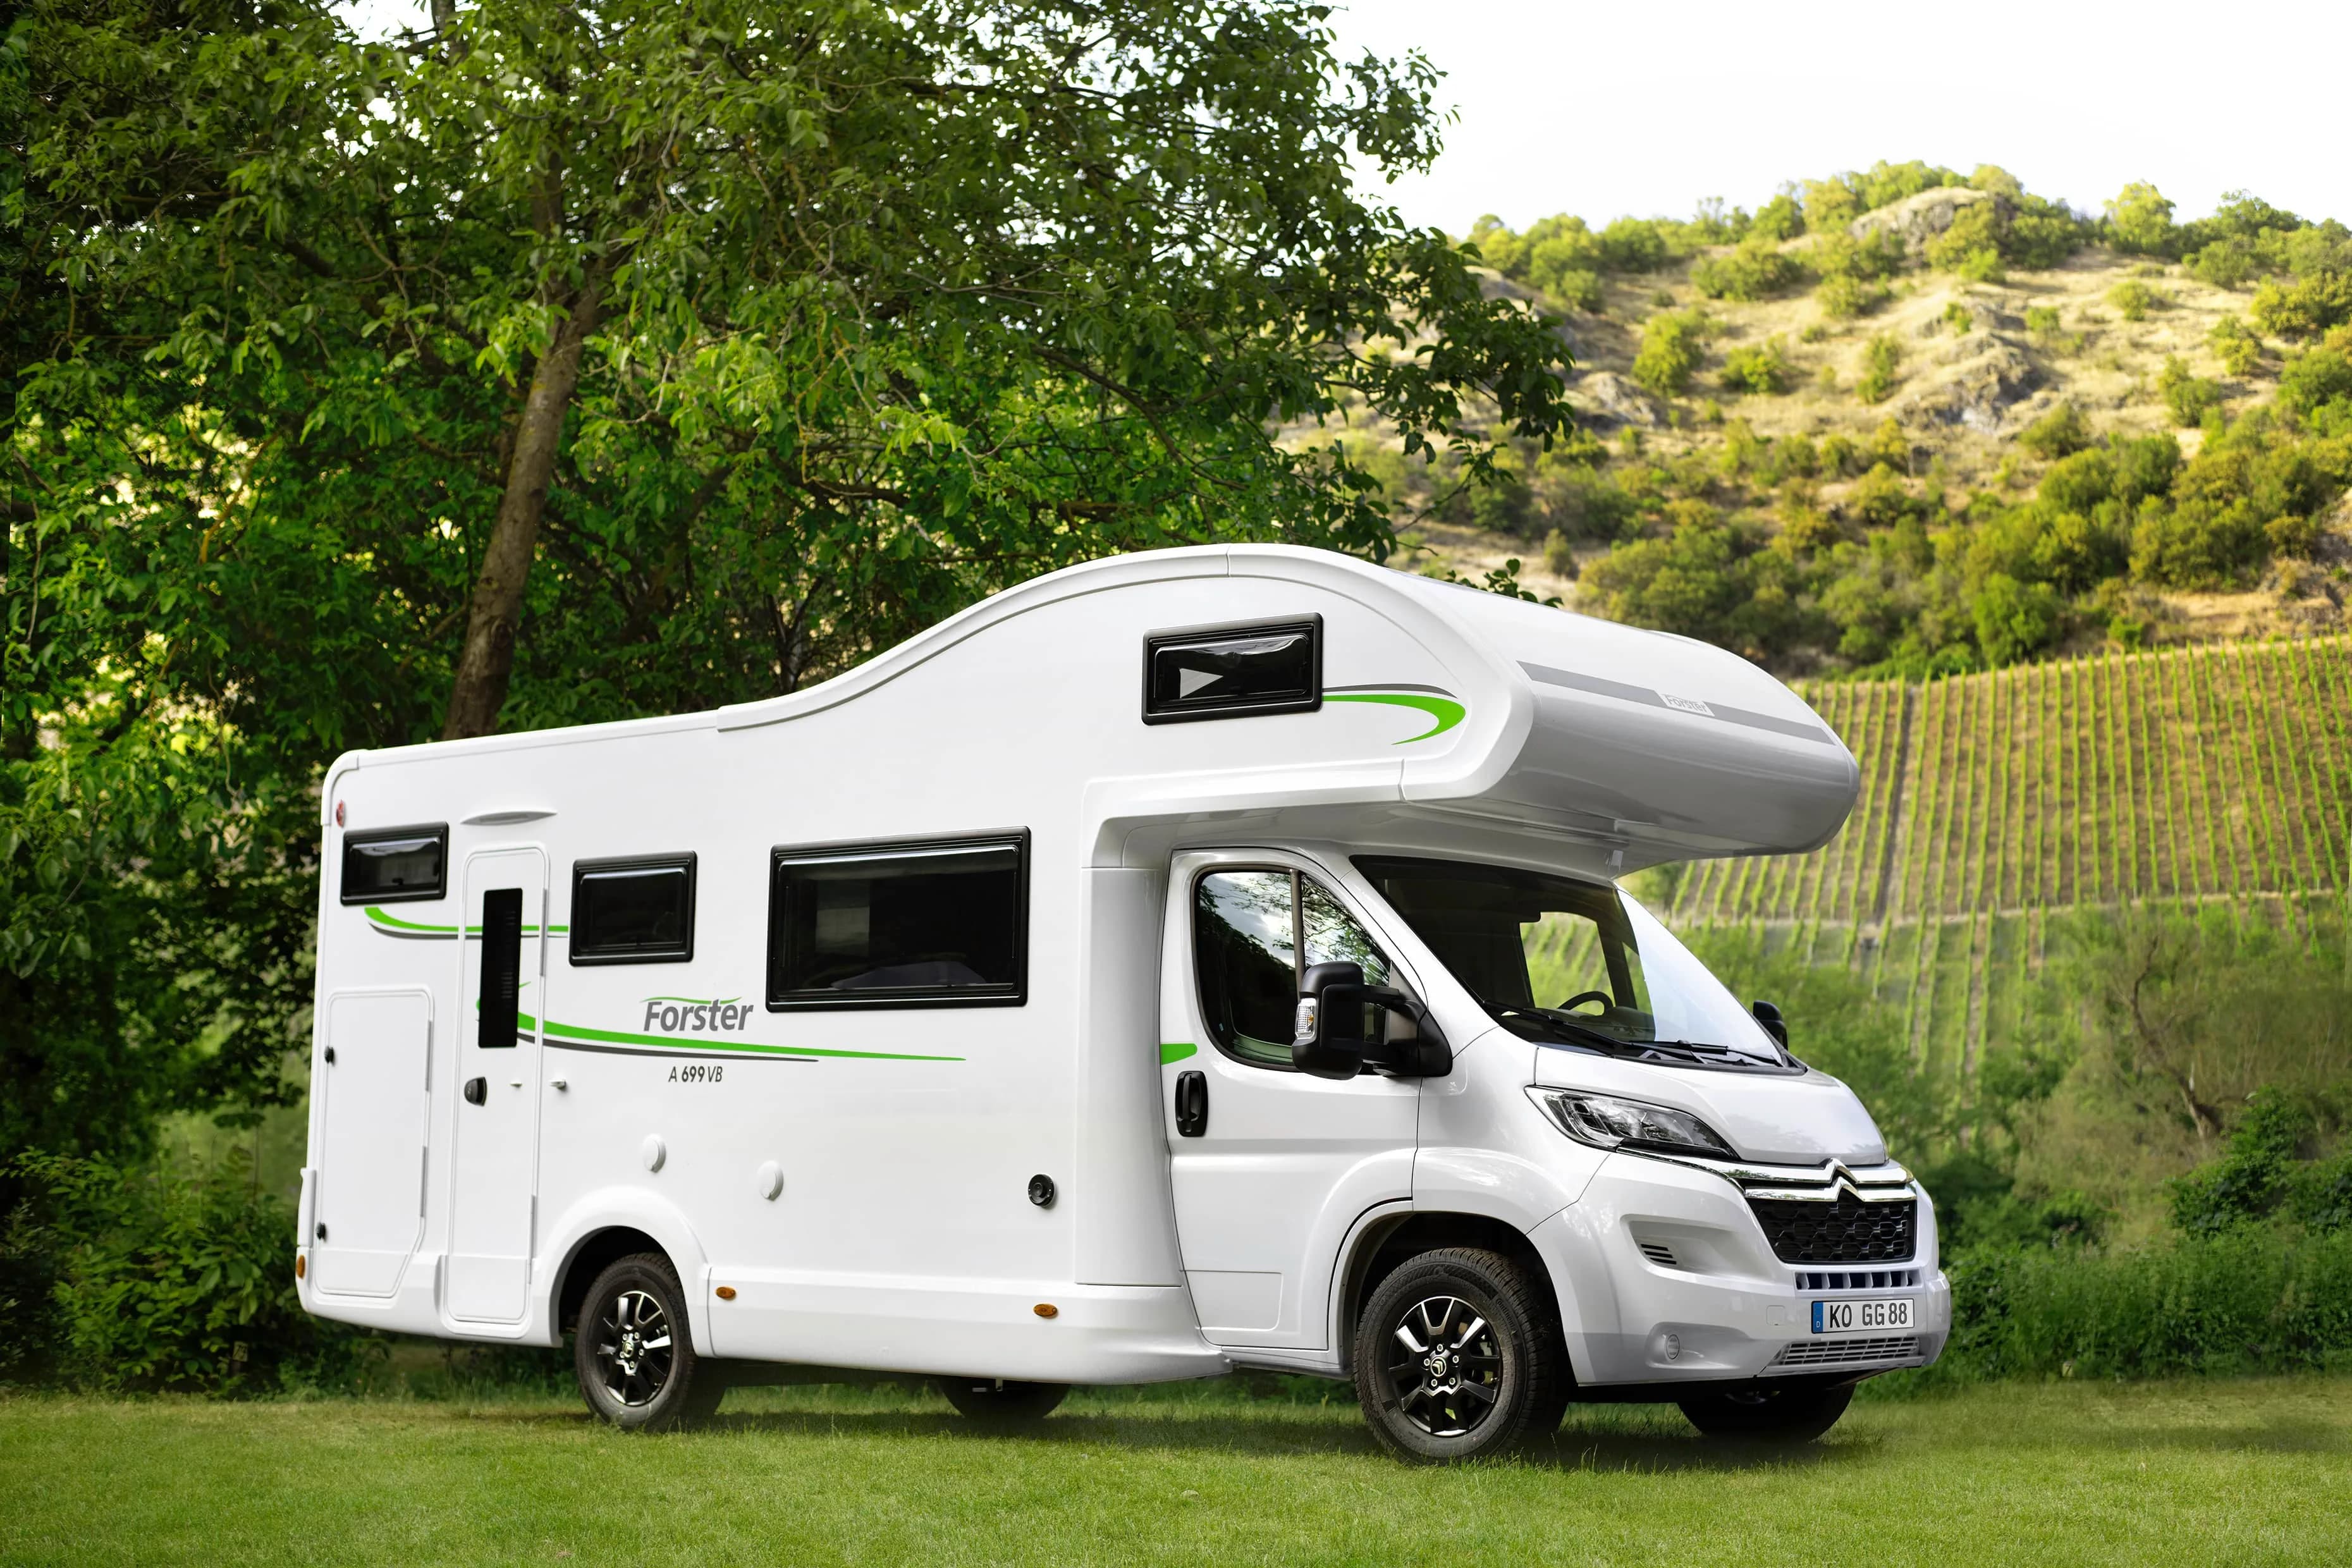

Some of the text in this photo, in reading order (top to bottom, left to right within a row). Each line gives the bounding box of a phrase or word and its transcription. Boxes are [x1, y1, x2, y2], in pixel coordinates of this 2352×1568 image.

[1665, 694, 1708, 713] Forster
[643, 998, 754, 1032] Forster
[668, 1065, 723, 1083] A 699 VB
[1829, 1304, 1853, 1328] KO
